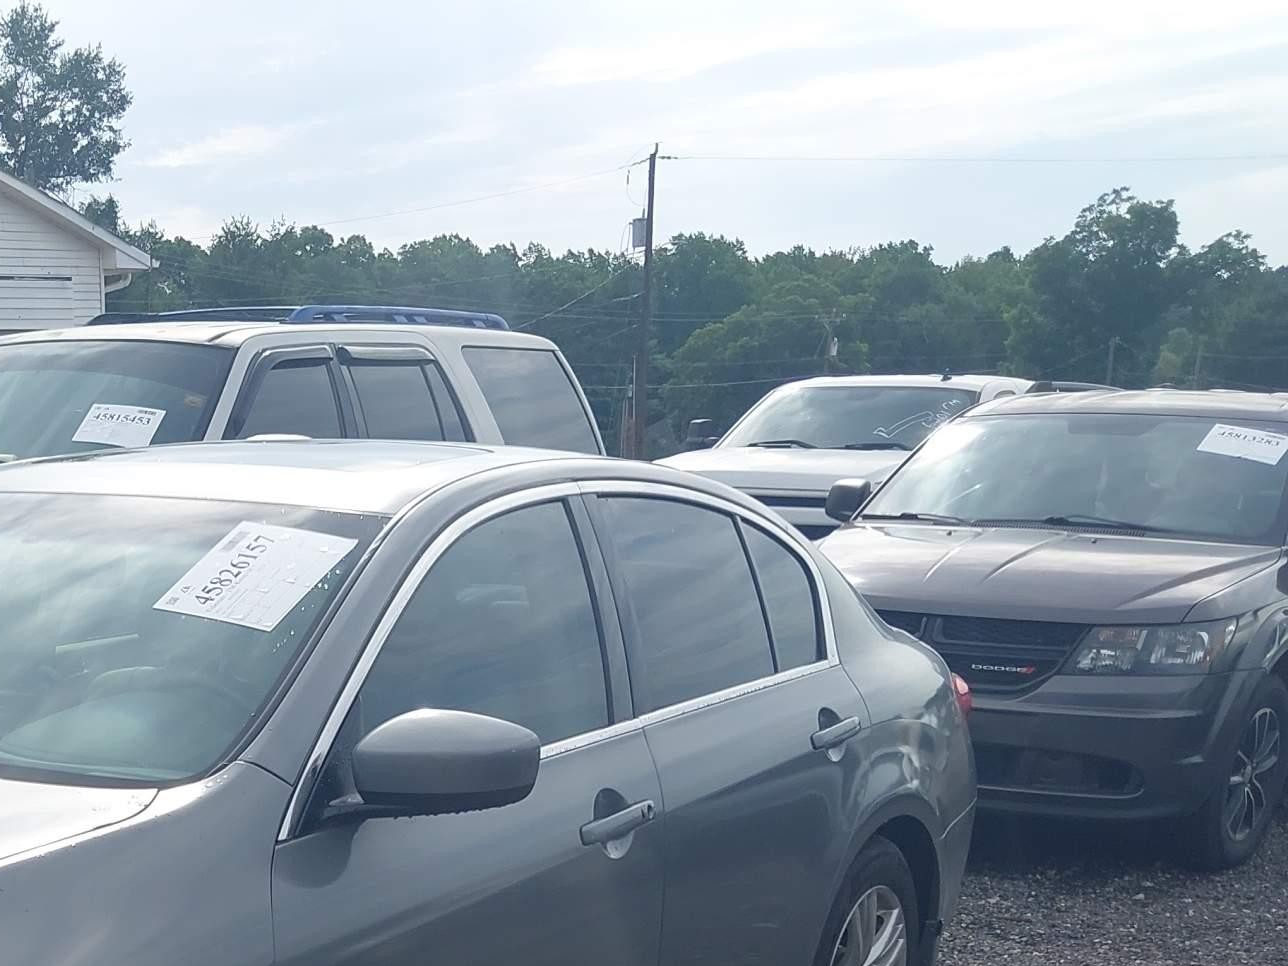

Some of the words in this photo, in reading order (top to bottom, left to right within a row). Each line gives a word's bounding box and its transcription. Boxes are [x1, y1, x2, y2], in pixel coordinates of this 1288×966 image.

[93, 412, 151, 425] 45815453
[194, 534, 277, 607] 45826157
[971, 663, 1027, 674] DODGE
